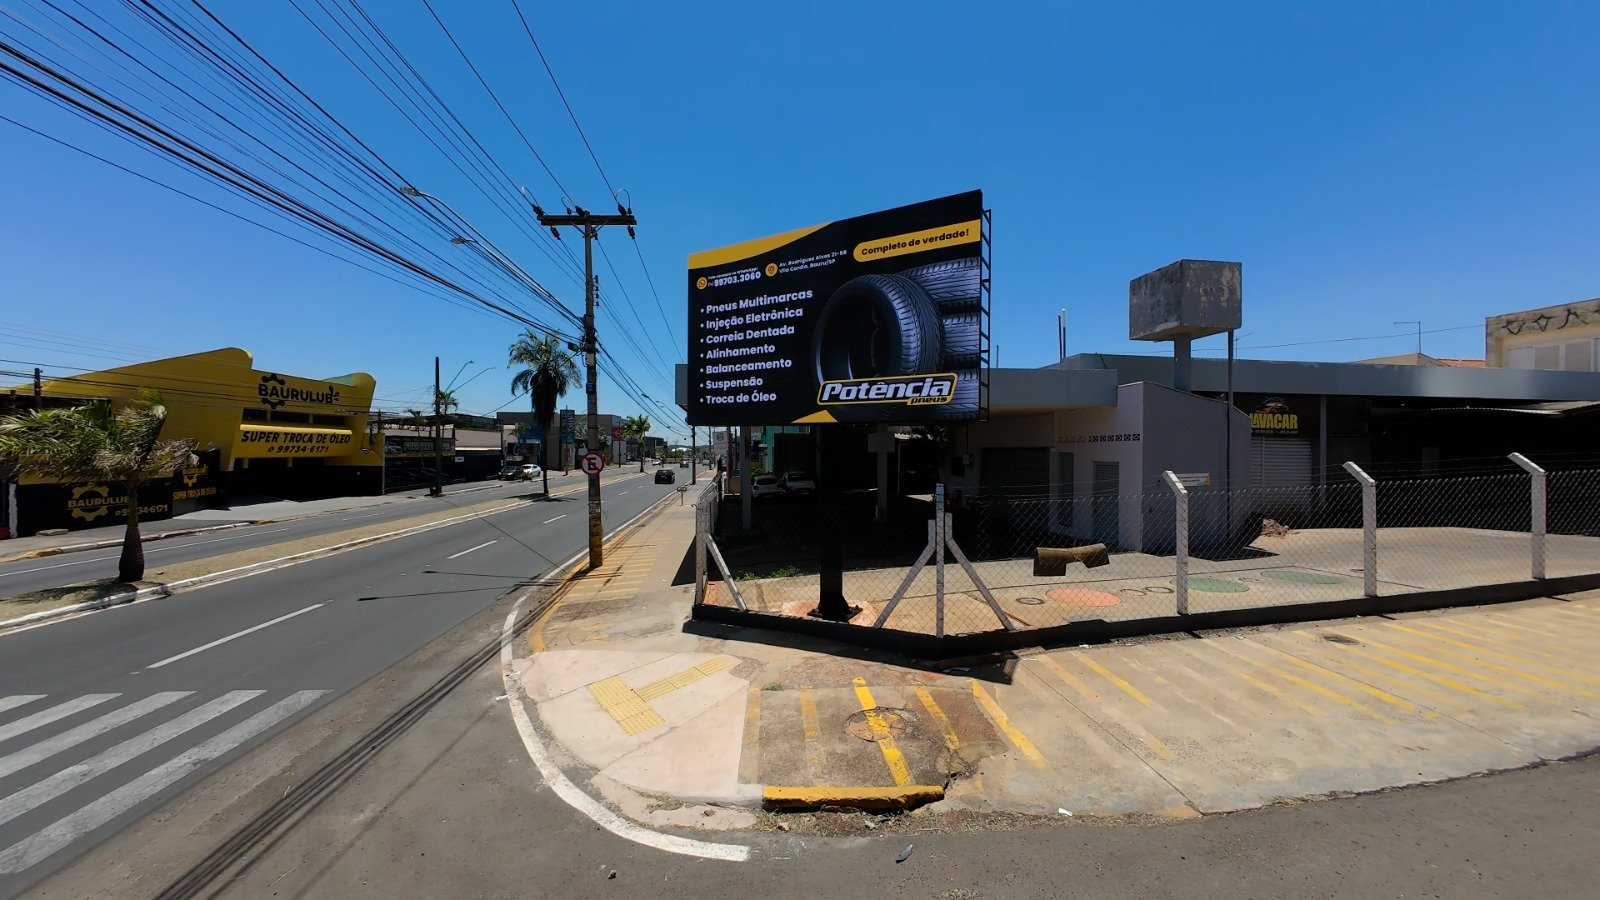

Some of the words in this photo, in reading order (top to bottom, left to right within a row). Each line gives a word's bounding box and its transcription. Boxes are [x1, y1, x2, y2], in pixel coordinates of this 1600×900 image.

[861, 243, 907, 256] Completo
[908, 239, 921, 247] de
[922, 229, 969, 244] verdade!
[809, 258, 836, 268] Bauru/SP
[714, 271, 762, 287] 99703.3060
[706, 301, 738, 314] Pneus
[739, 290, 813, 309] Multimarcas
[706, 316, 744, 331] Injeção
[745, 307, 803, 323] Eletrônica
[706, 332, 744, 344] Correia
[746, 325, 795, 339] Dentada
[706, 344, 776, 359] Alinhamento
[706, 358, 792, 374] Balanceamento
[706, 376, 763, 391] Suspensão
[821, 378, 951, 401] Potência
[706, 394, 735, 404] Troca
[736, 393, 749, 403] de
[751, 389, 777, 402] Óleo
[241, 431, 279, 443] SUPER
[283, 433, 313, 444] TROCA
[315, 434, 327, 444] DE
[329, 432, 351, 444] ÓLEO
[588, 457, 597, 471] E
